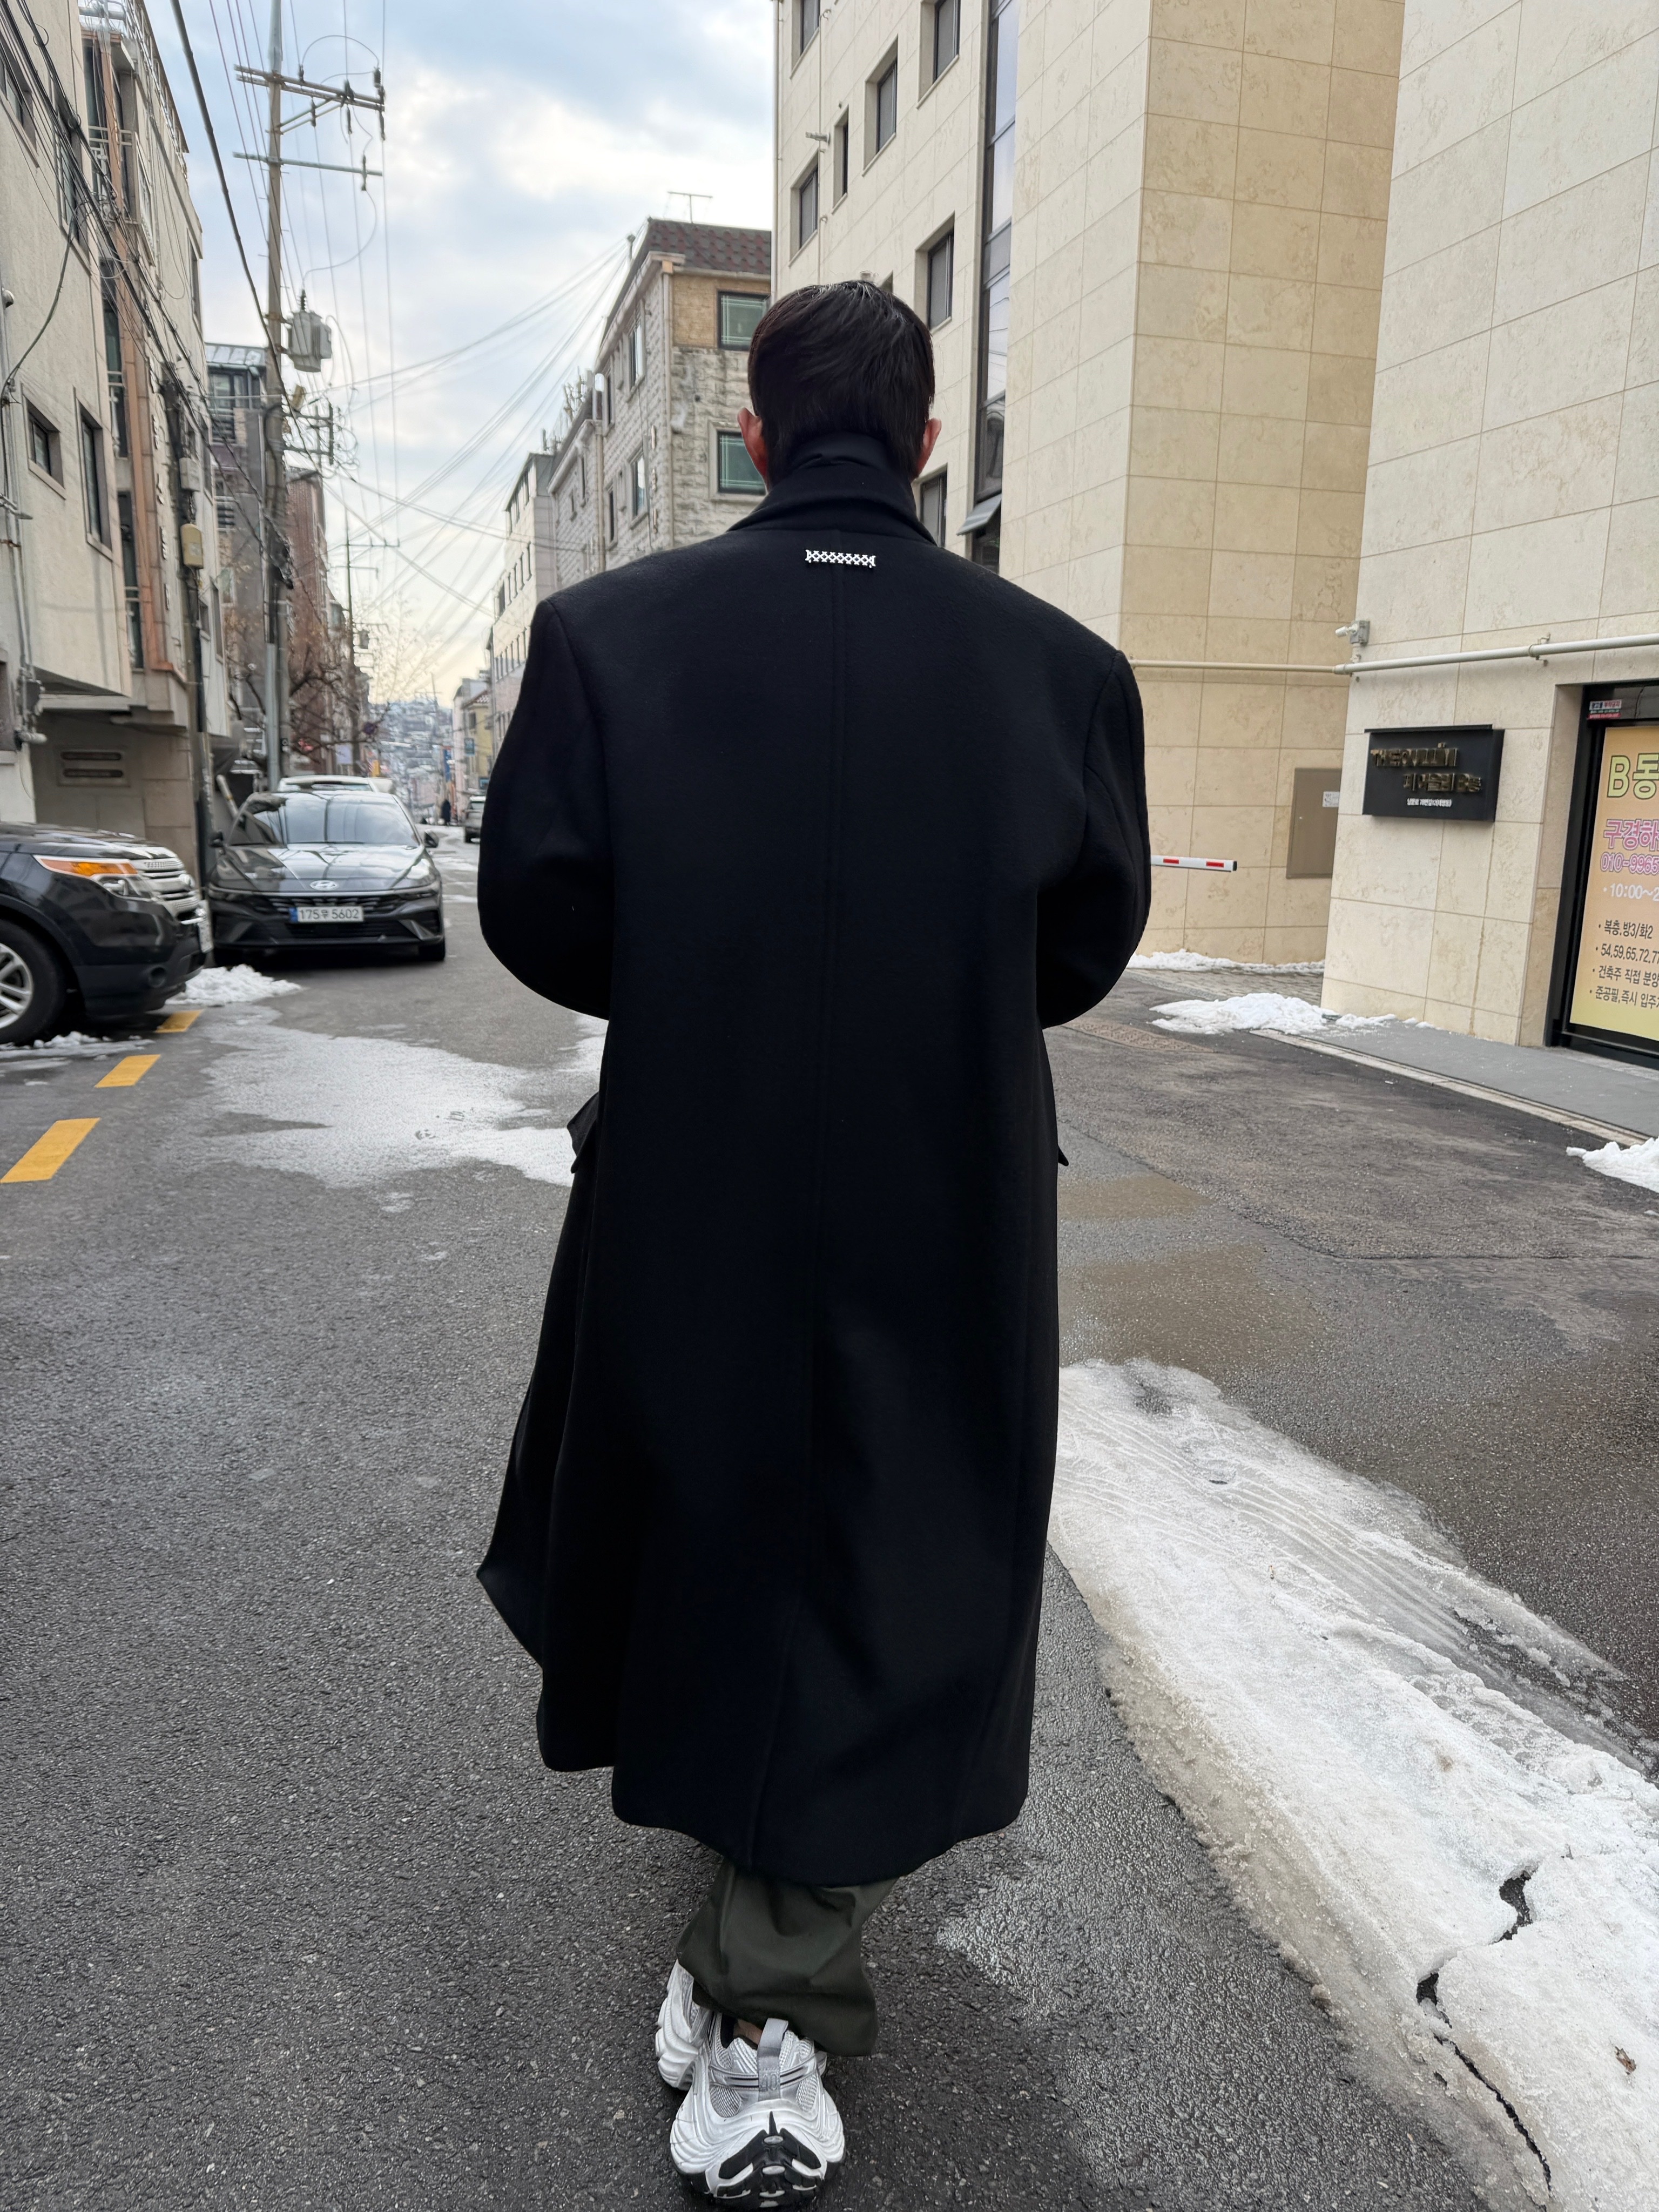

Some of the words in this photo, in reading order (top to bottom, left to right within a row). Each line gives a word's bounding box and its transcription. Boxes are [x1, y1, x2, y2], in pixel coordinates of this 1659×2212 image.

[1607, 752, 1659, 799] B동
[332, 908, 360, 919] 5602
[1599, 965, 1621, 981] 건축주
[1624, 969, 1641, 984] 직접
